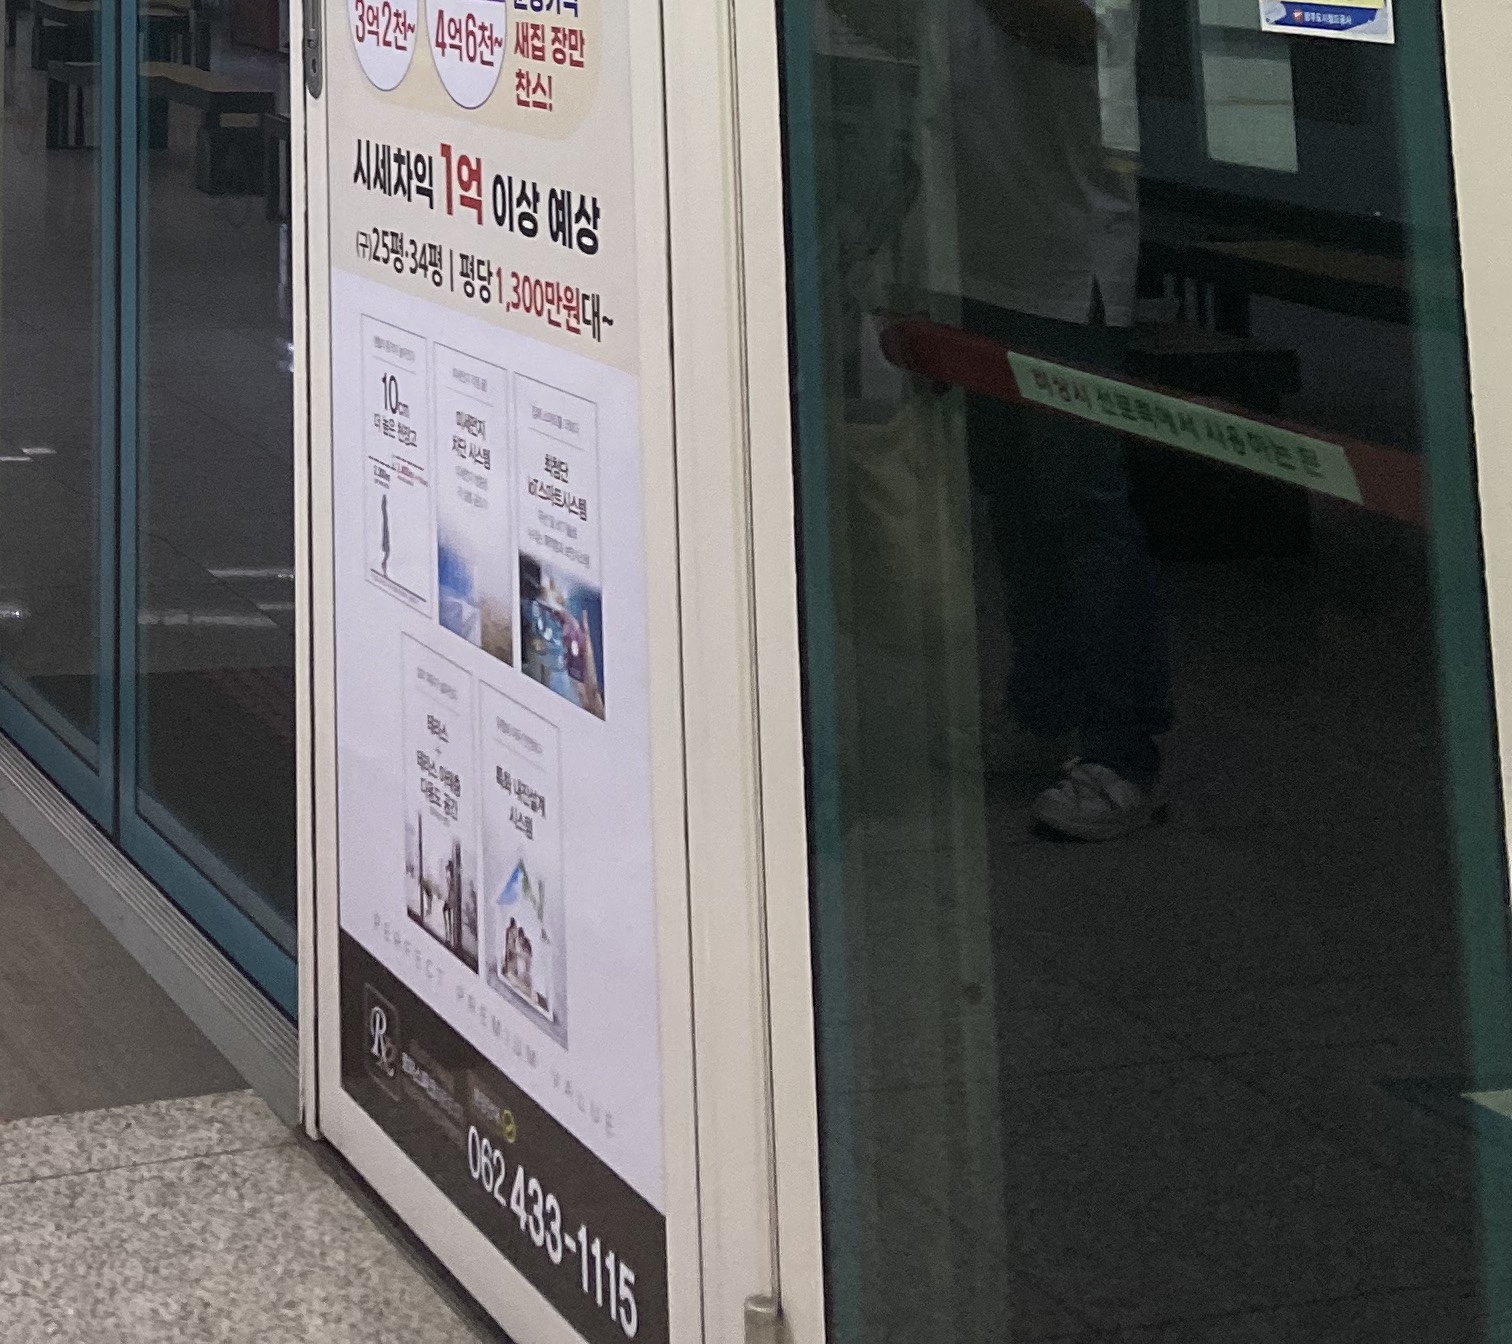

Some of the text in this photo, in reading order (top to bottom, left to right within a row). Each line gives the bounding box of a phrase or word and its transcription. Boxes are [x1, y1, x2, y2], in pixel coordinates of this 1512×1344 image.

[513, 20, 586, 69] 새집 장만
[352, 138, 601, 256] 시세차익 1억 이상 예상
[467, 1124, 640, 1340] 062 433-1115
